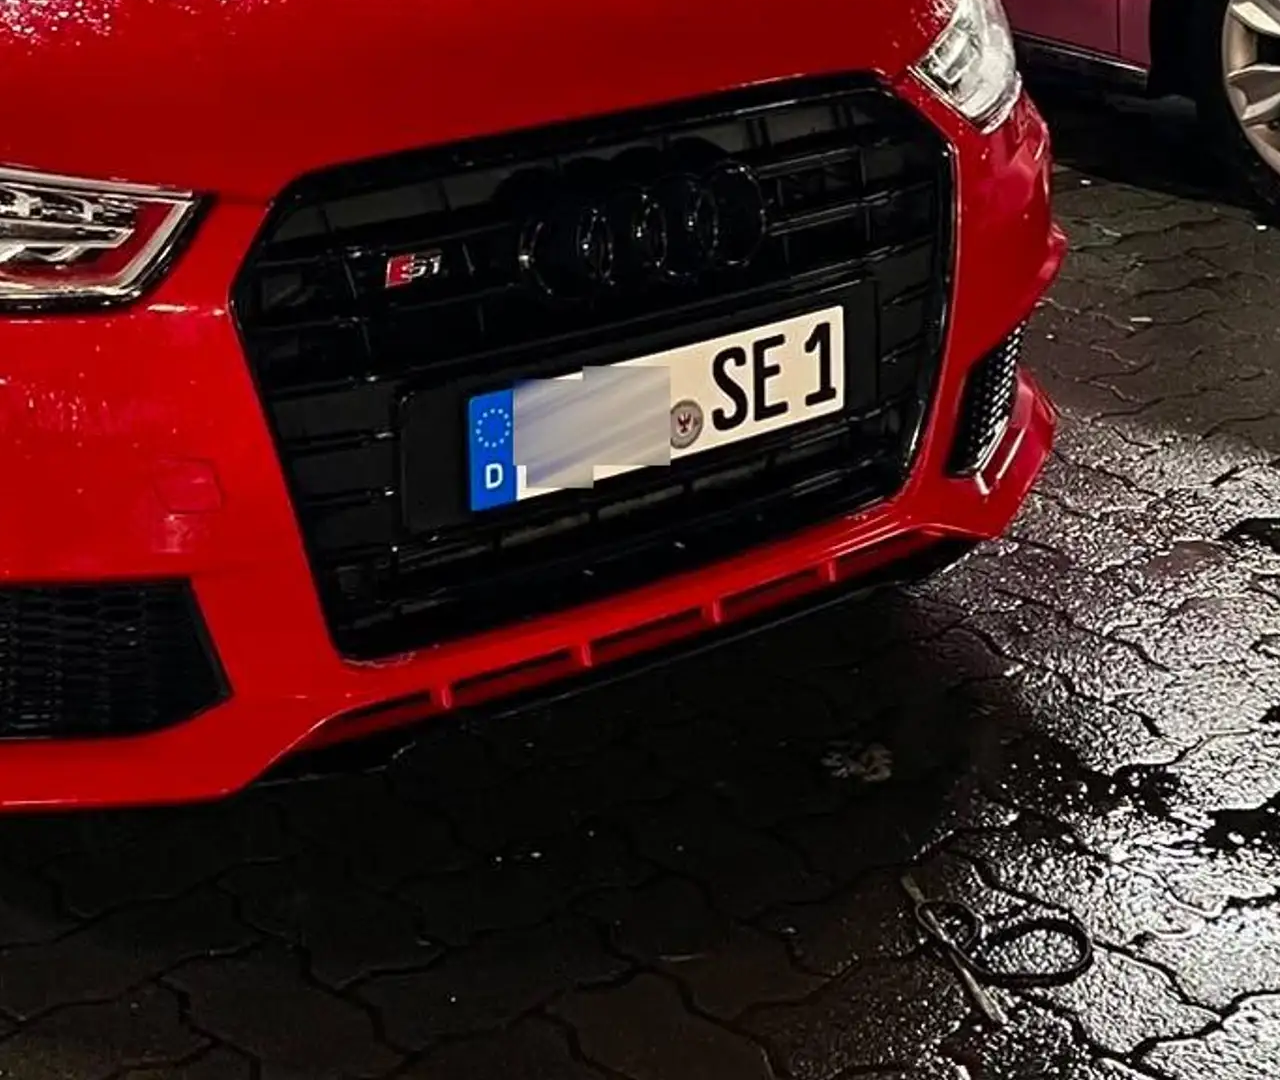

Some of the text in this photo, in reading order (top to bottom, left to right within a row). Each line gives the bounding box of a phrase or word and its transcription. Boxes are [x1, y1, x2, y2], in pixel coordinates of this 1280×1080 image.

[711, 322, 837, 431] SE 1
[485, 462, 503, 489] D
